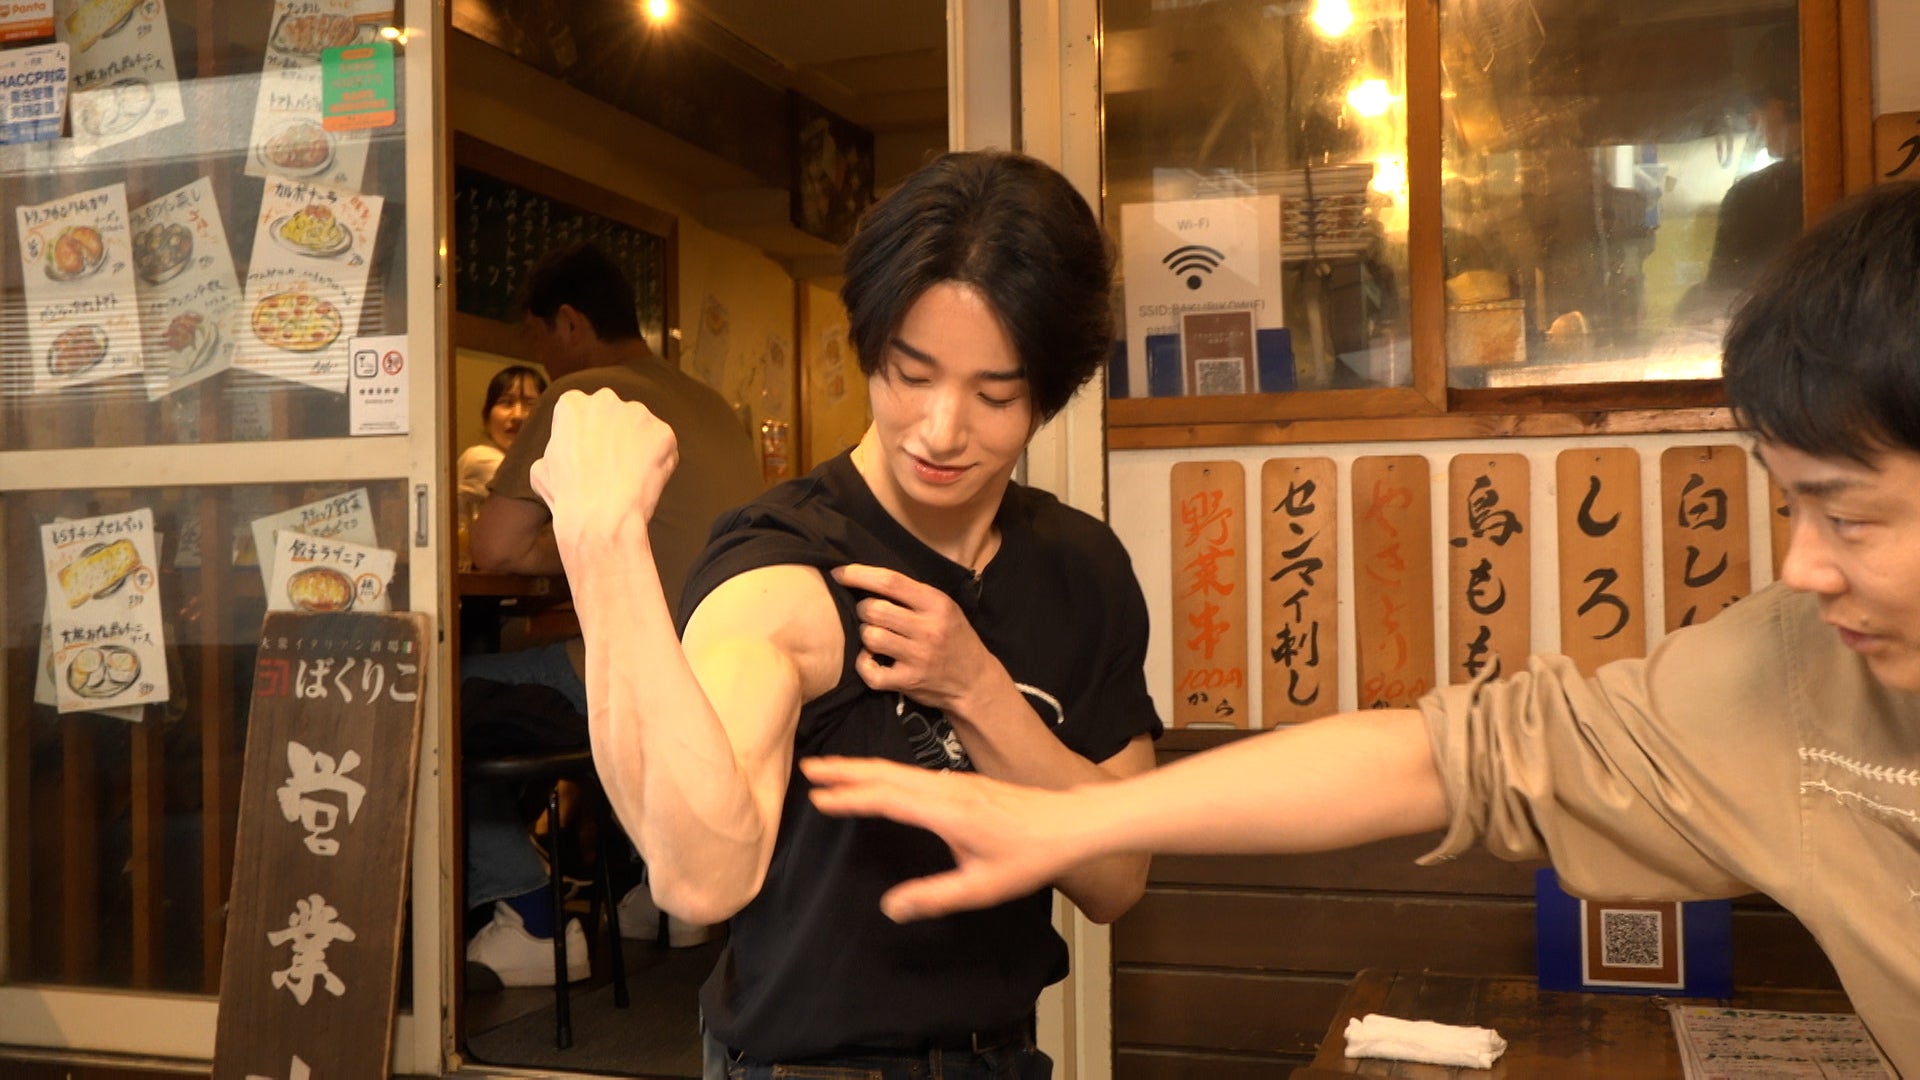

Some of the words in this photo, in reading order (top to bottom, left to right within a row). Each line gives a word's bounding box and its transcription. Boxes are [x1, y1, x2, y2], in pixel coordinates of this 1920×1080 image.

[1177, 218, 1210, 230] Wi-Fi
[1181, 489, 1236, 660] 野菜串
[1270, 479, 1324, 706] センマイ刺し
[1364, 479, 1413, 671] やきとり
[1577, 475, 1630, 640] しろ
[1678, 473, 1740, 629] 白し
[294, 658, 417, 703] ばくりこ
